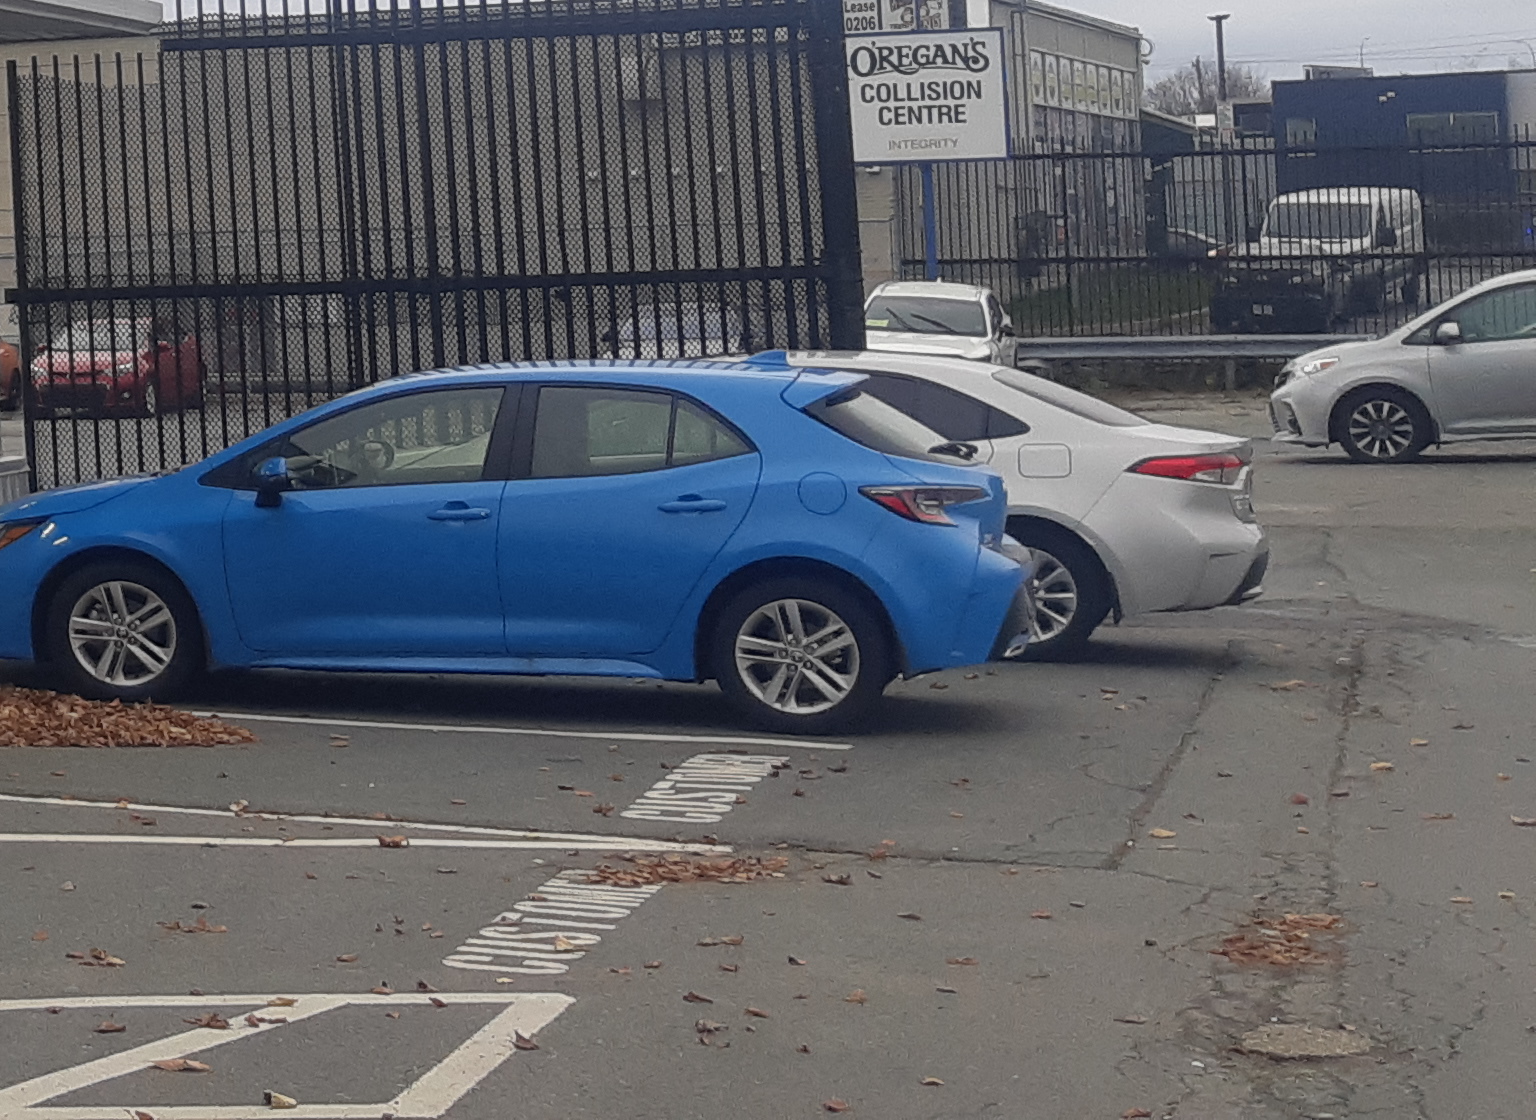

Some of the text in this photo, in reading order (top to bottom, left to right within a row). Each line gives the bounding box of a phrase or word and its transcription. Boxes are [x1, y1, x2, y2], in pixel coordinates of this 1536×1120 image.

[844, 1, 876, 13] Lease
[845, 16, 877, 31] 0206
[849, 36, 990, 78] O'REGAN'S
[860, 80, 982, 103] COLLISION
[878, 104, 968, 126] CENTRE
[888, 138, 959, 150] INTEGRITY
[441, 868, 668, 975] CUSTOME
